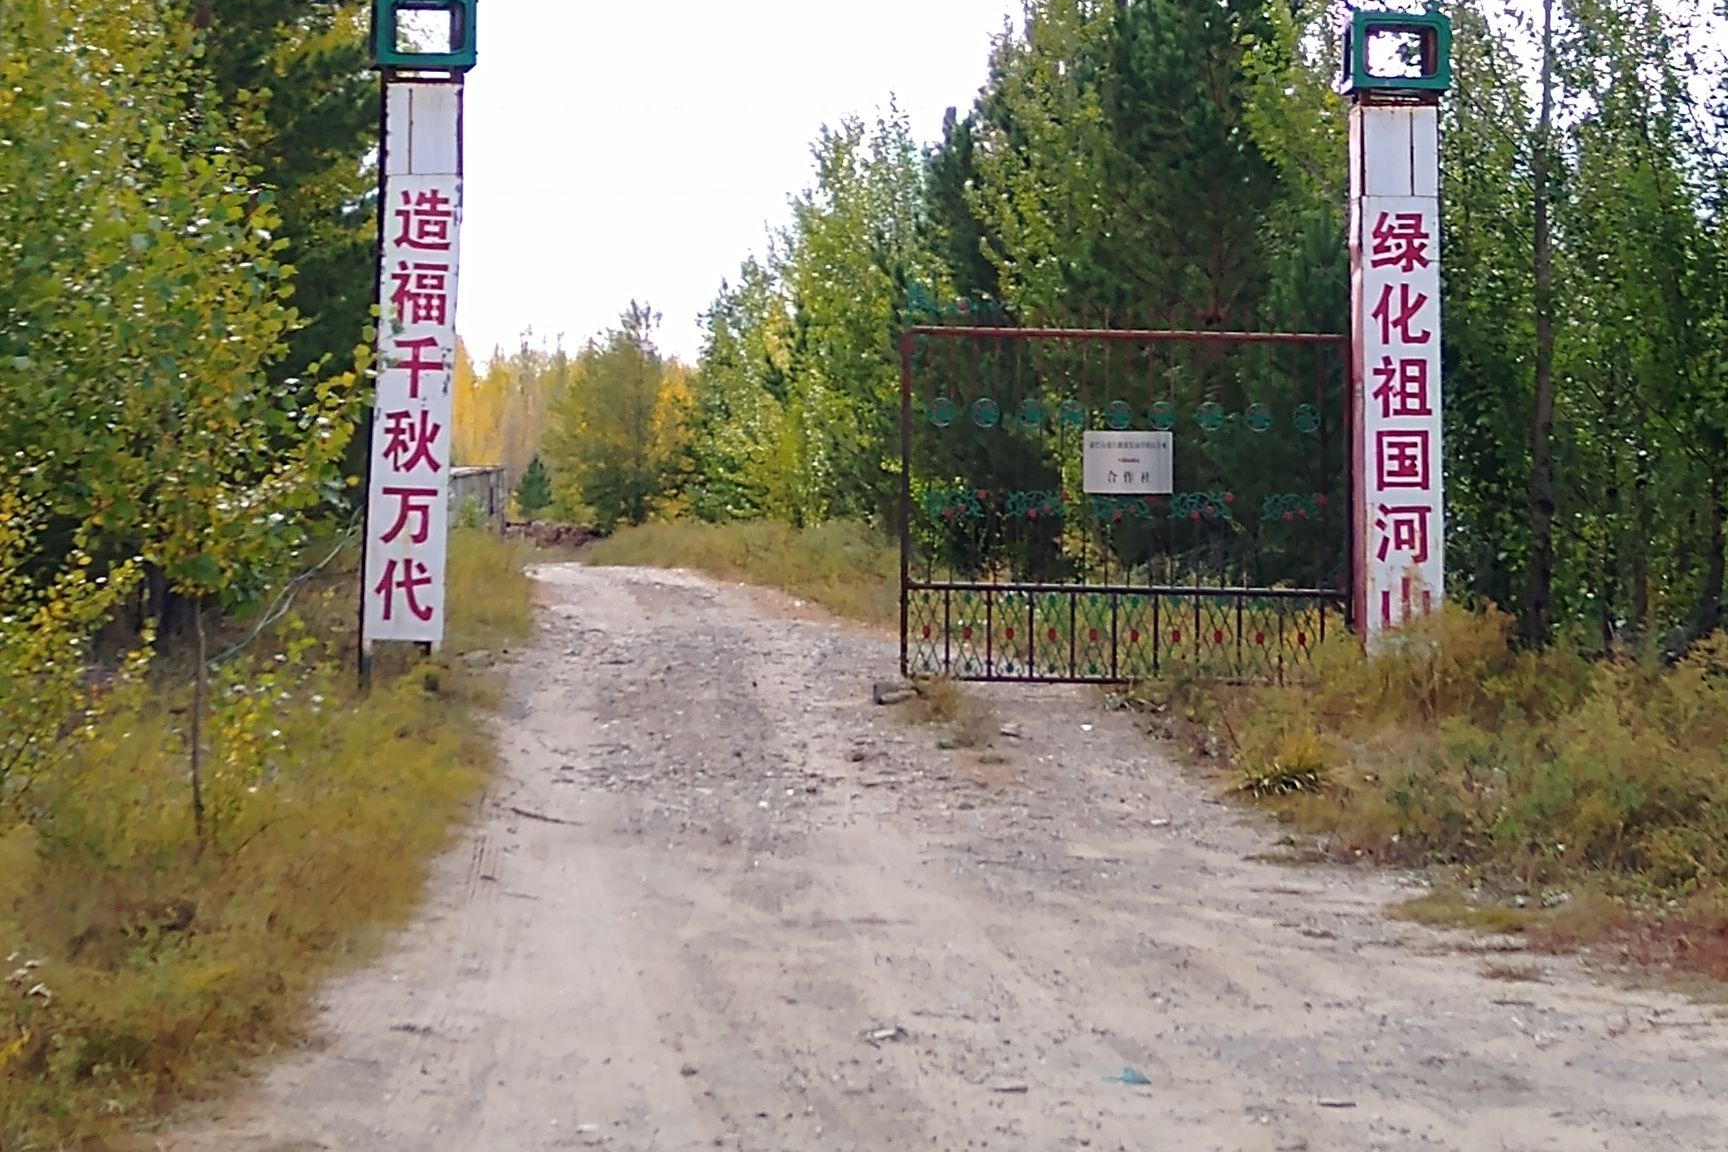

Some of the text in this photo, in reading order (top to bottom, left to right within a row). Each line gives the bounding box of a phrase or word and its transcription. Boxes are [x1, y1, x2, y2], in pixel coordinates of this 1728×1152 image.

[374, 189, 453, 623] 造福千秋万代
[1370, 210, 1433, 631] 绿化祖国河山
